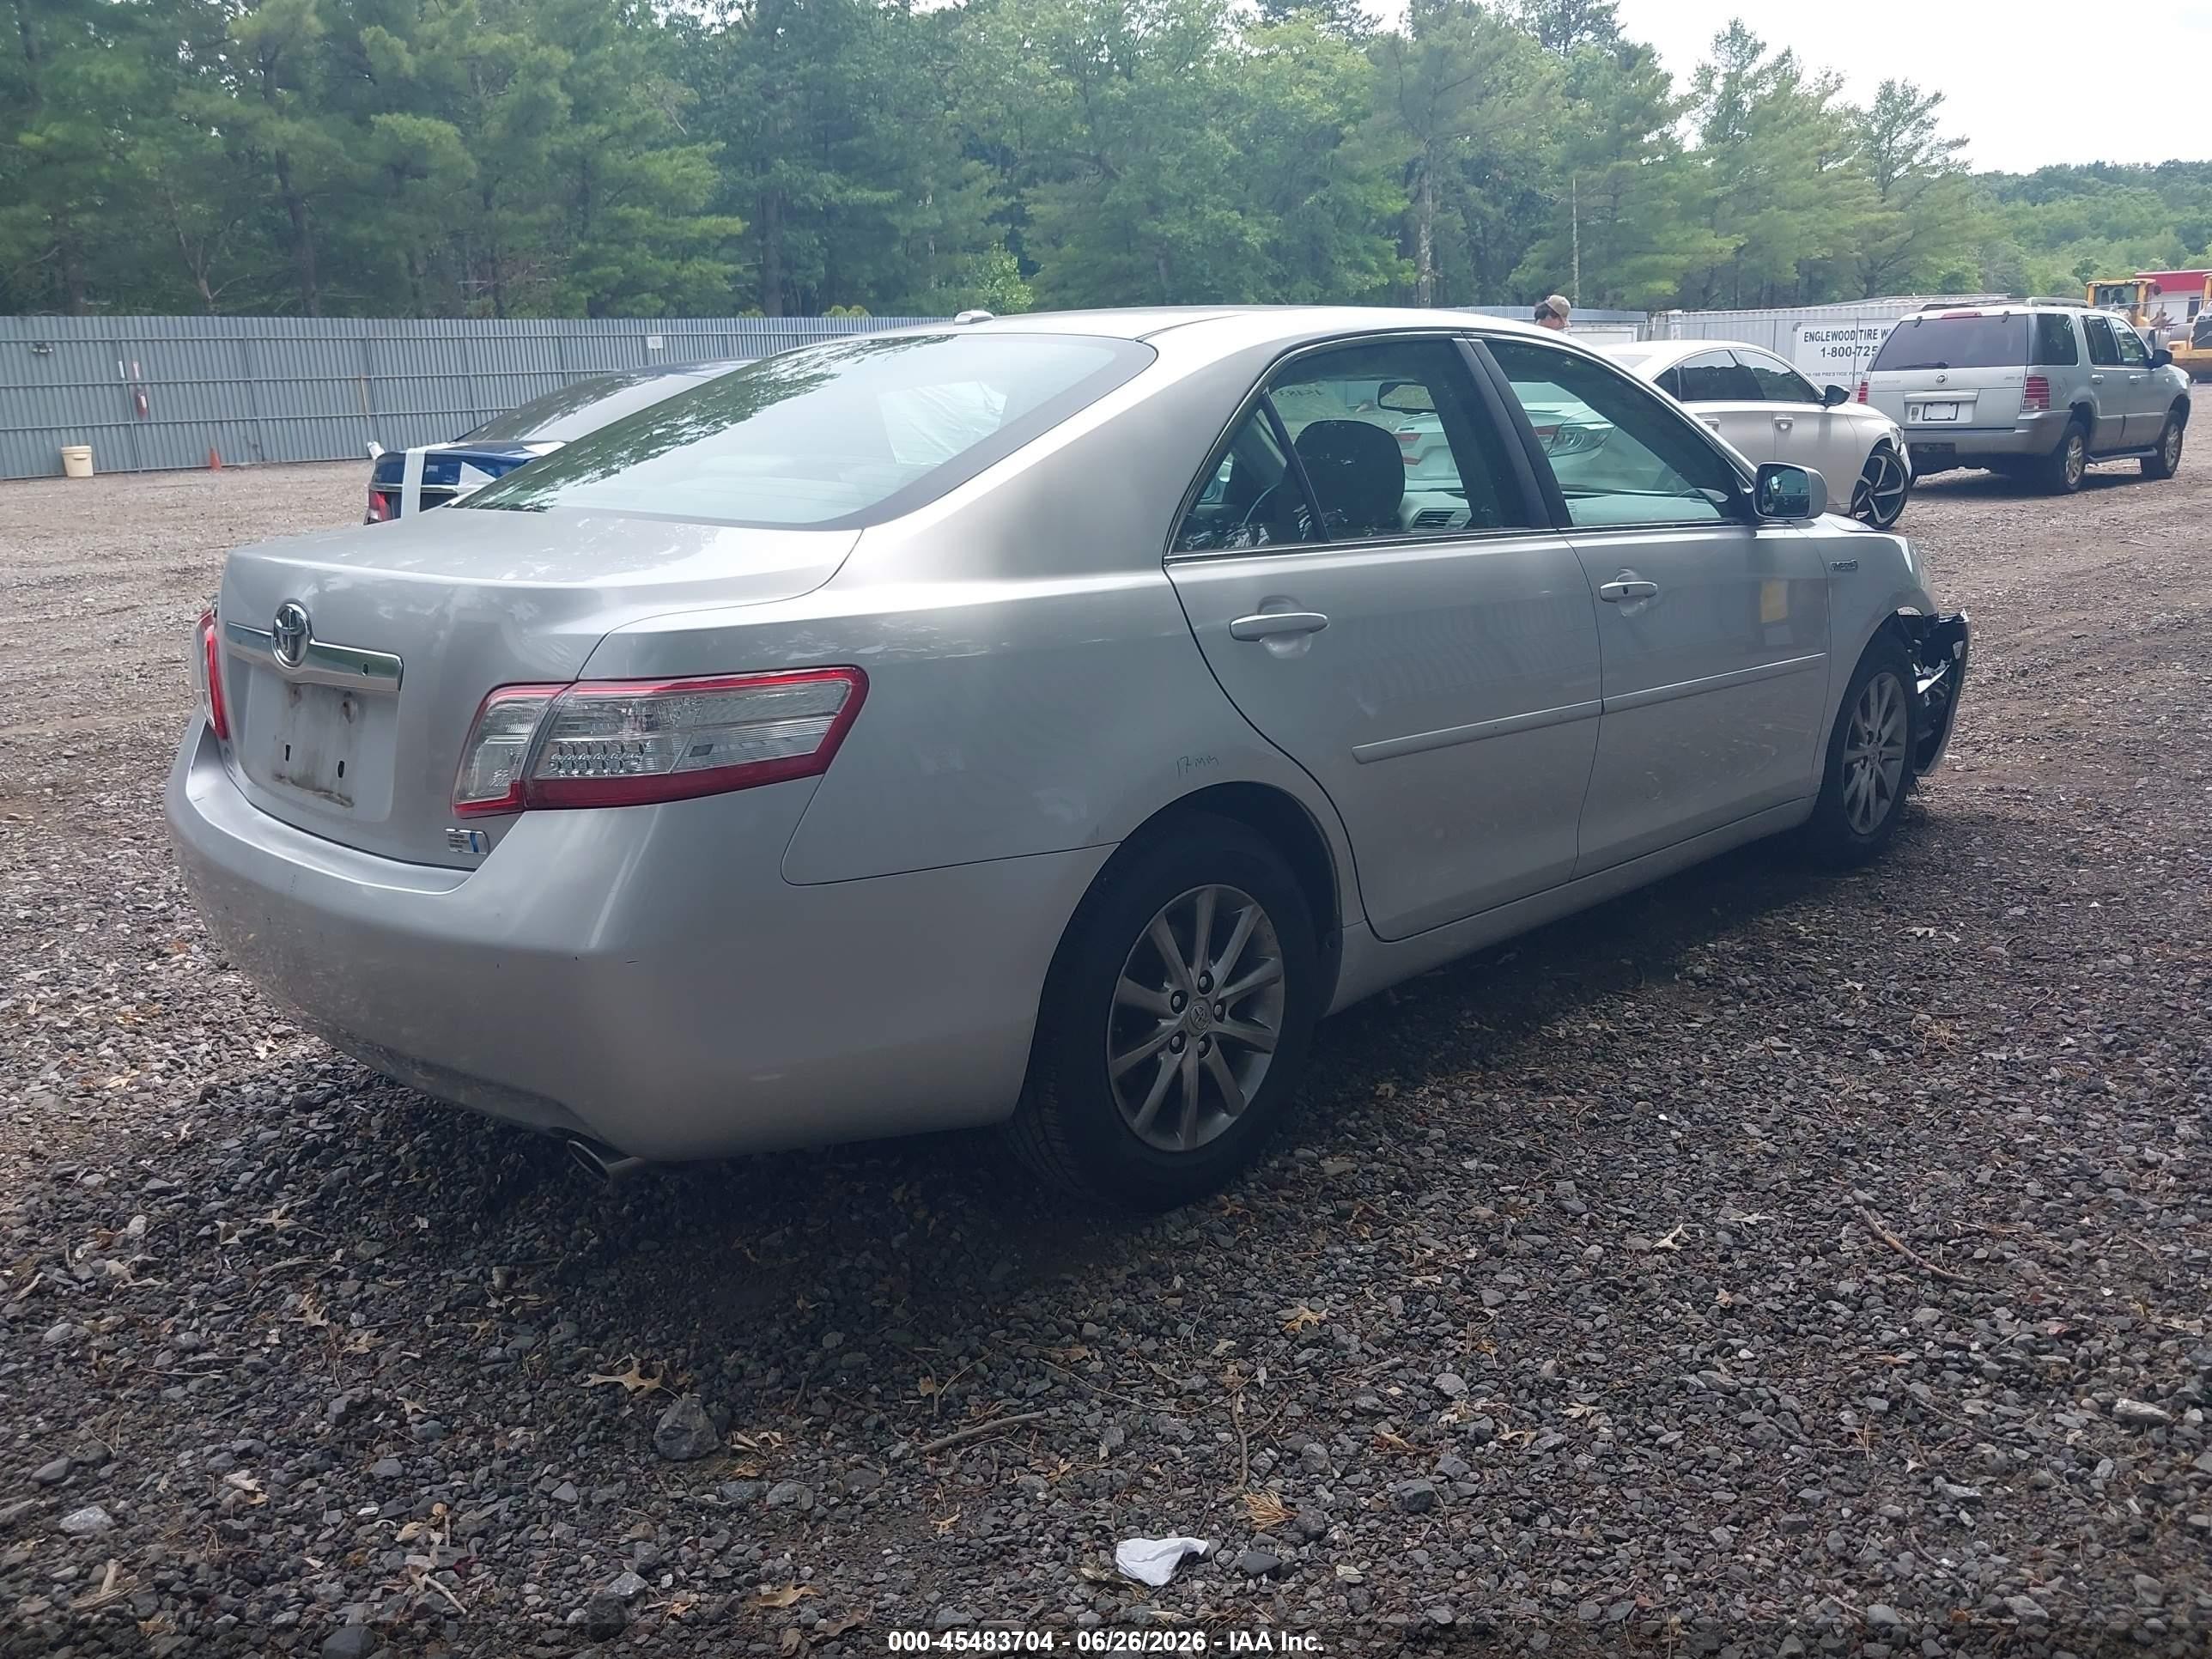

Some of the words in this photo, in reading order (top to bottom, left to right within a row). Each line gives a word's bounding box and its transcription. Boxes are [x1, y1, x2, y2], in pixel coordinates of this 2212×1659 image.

[1803, 330, 1856, 343] ENGLEWOOD
[1858, 328, 1879, 340] TIRE
[1881, 328, 1891, 339] W
